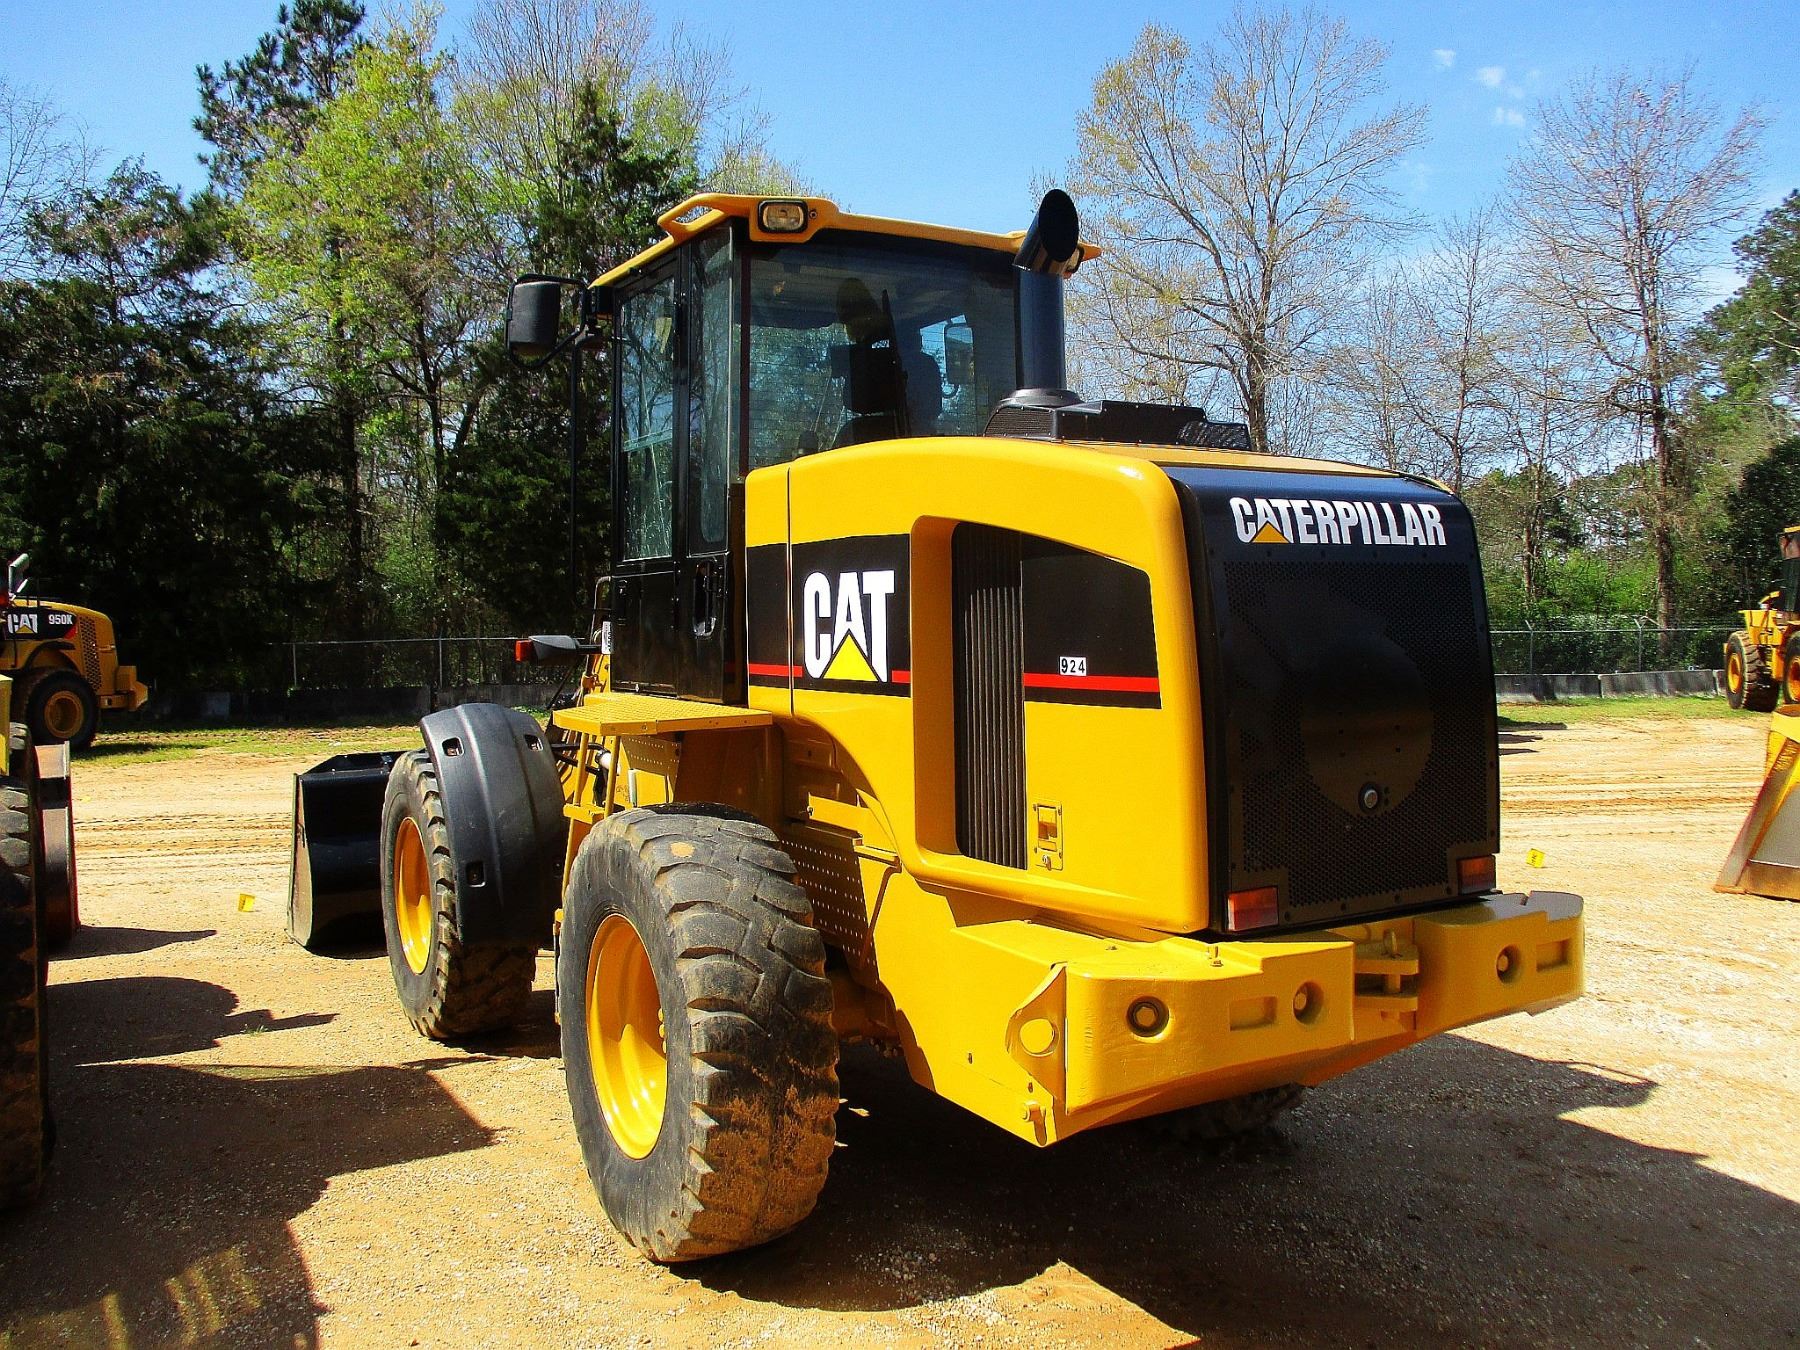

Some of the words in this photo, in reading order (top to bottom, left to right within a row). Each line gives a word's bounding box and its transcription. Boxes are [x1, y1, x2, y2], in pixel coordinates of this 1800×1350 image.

[1230, 497, 1447, 546] CATERPILLAR
[7, 613, 38, 634] CAT
[48, 614, 73, 625] 950K
[804, 570, 894, 682] CAT
[1061, 658, 1085, 673] 924
